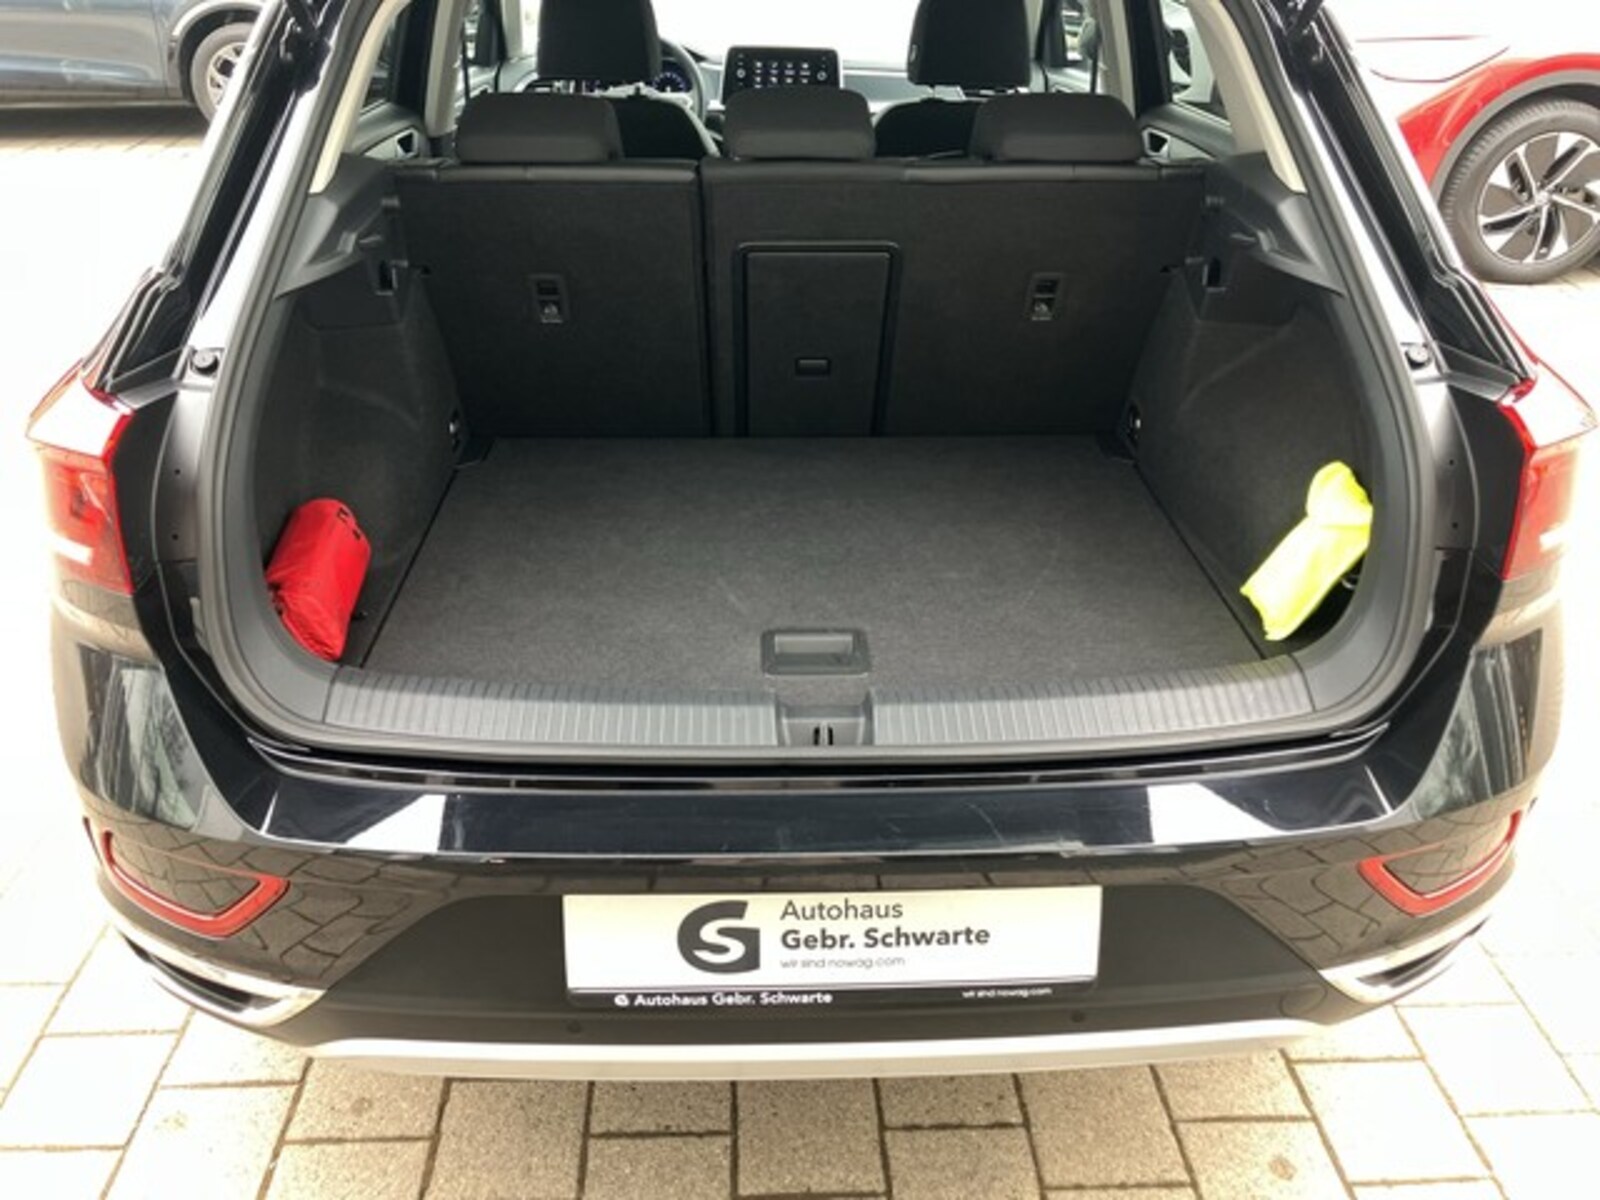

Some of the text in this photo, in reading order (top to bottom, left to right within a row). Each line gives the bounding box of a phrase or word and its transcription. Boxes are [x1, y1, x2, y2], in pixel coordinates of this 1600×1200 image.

[780, 898, 904, 921] Autohaus
[781, 926, 991, 950] Gebr. Schwarte
[801, 957, 826, 969] sind
[634, 993, 708, 1007] Autohaus
[712, 992, 756, 1006] Gebr.
[759, 991, 834, 1005] Schwarte
